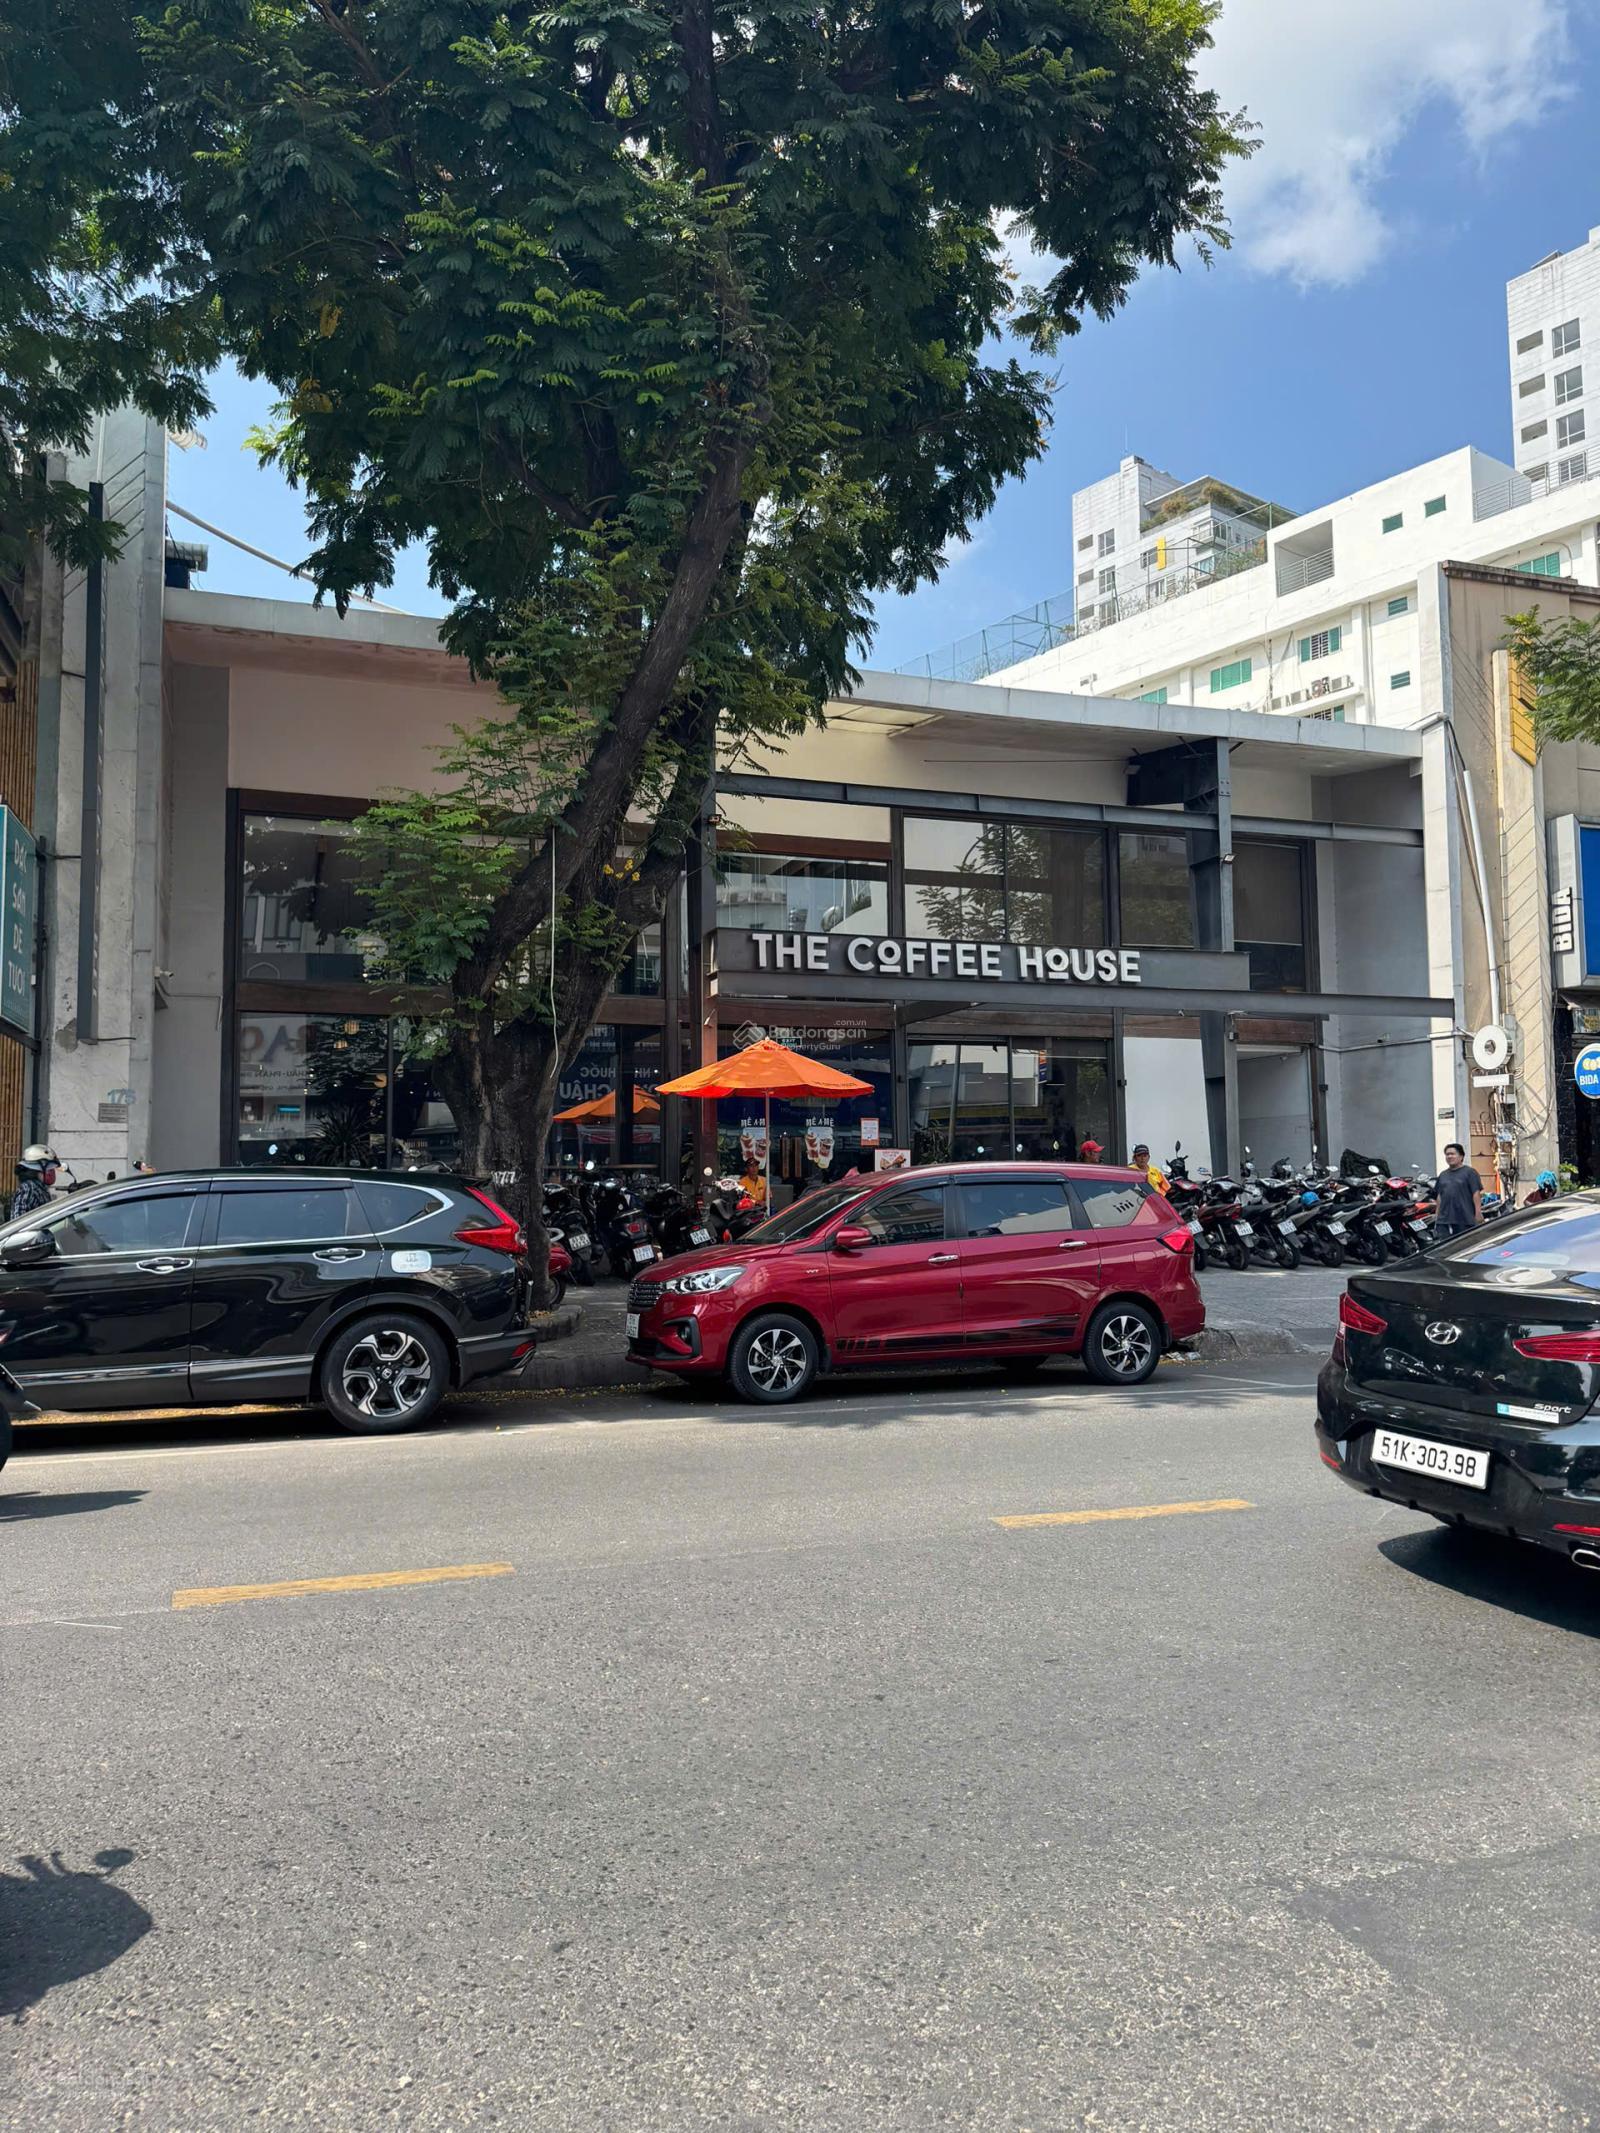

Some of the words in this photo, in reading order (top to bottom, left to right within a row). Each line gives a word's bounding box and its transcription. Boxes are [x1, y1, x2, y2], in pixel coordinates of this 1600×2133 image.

[1552, 887, 1573, 952] BIDA
[752, 933, 829, 970] THE
[847, 937, 1002, 977] COFFEE
[1018, 946, 1142, 983] HOUSE
[1579, 1073, 1599, 1085] BIDA
[1384, 1355, 1506, 1381] ELANTRA
[1534, 1402, 1572, 1414] Sport
